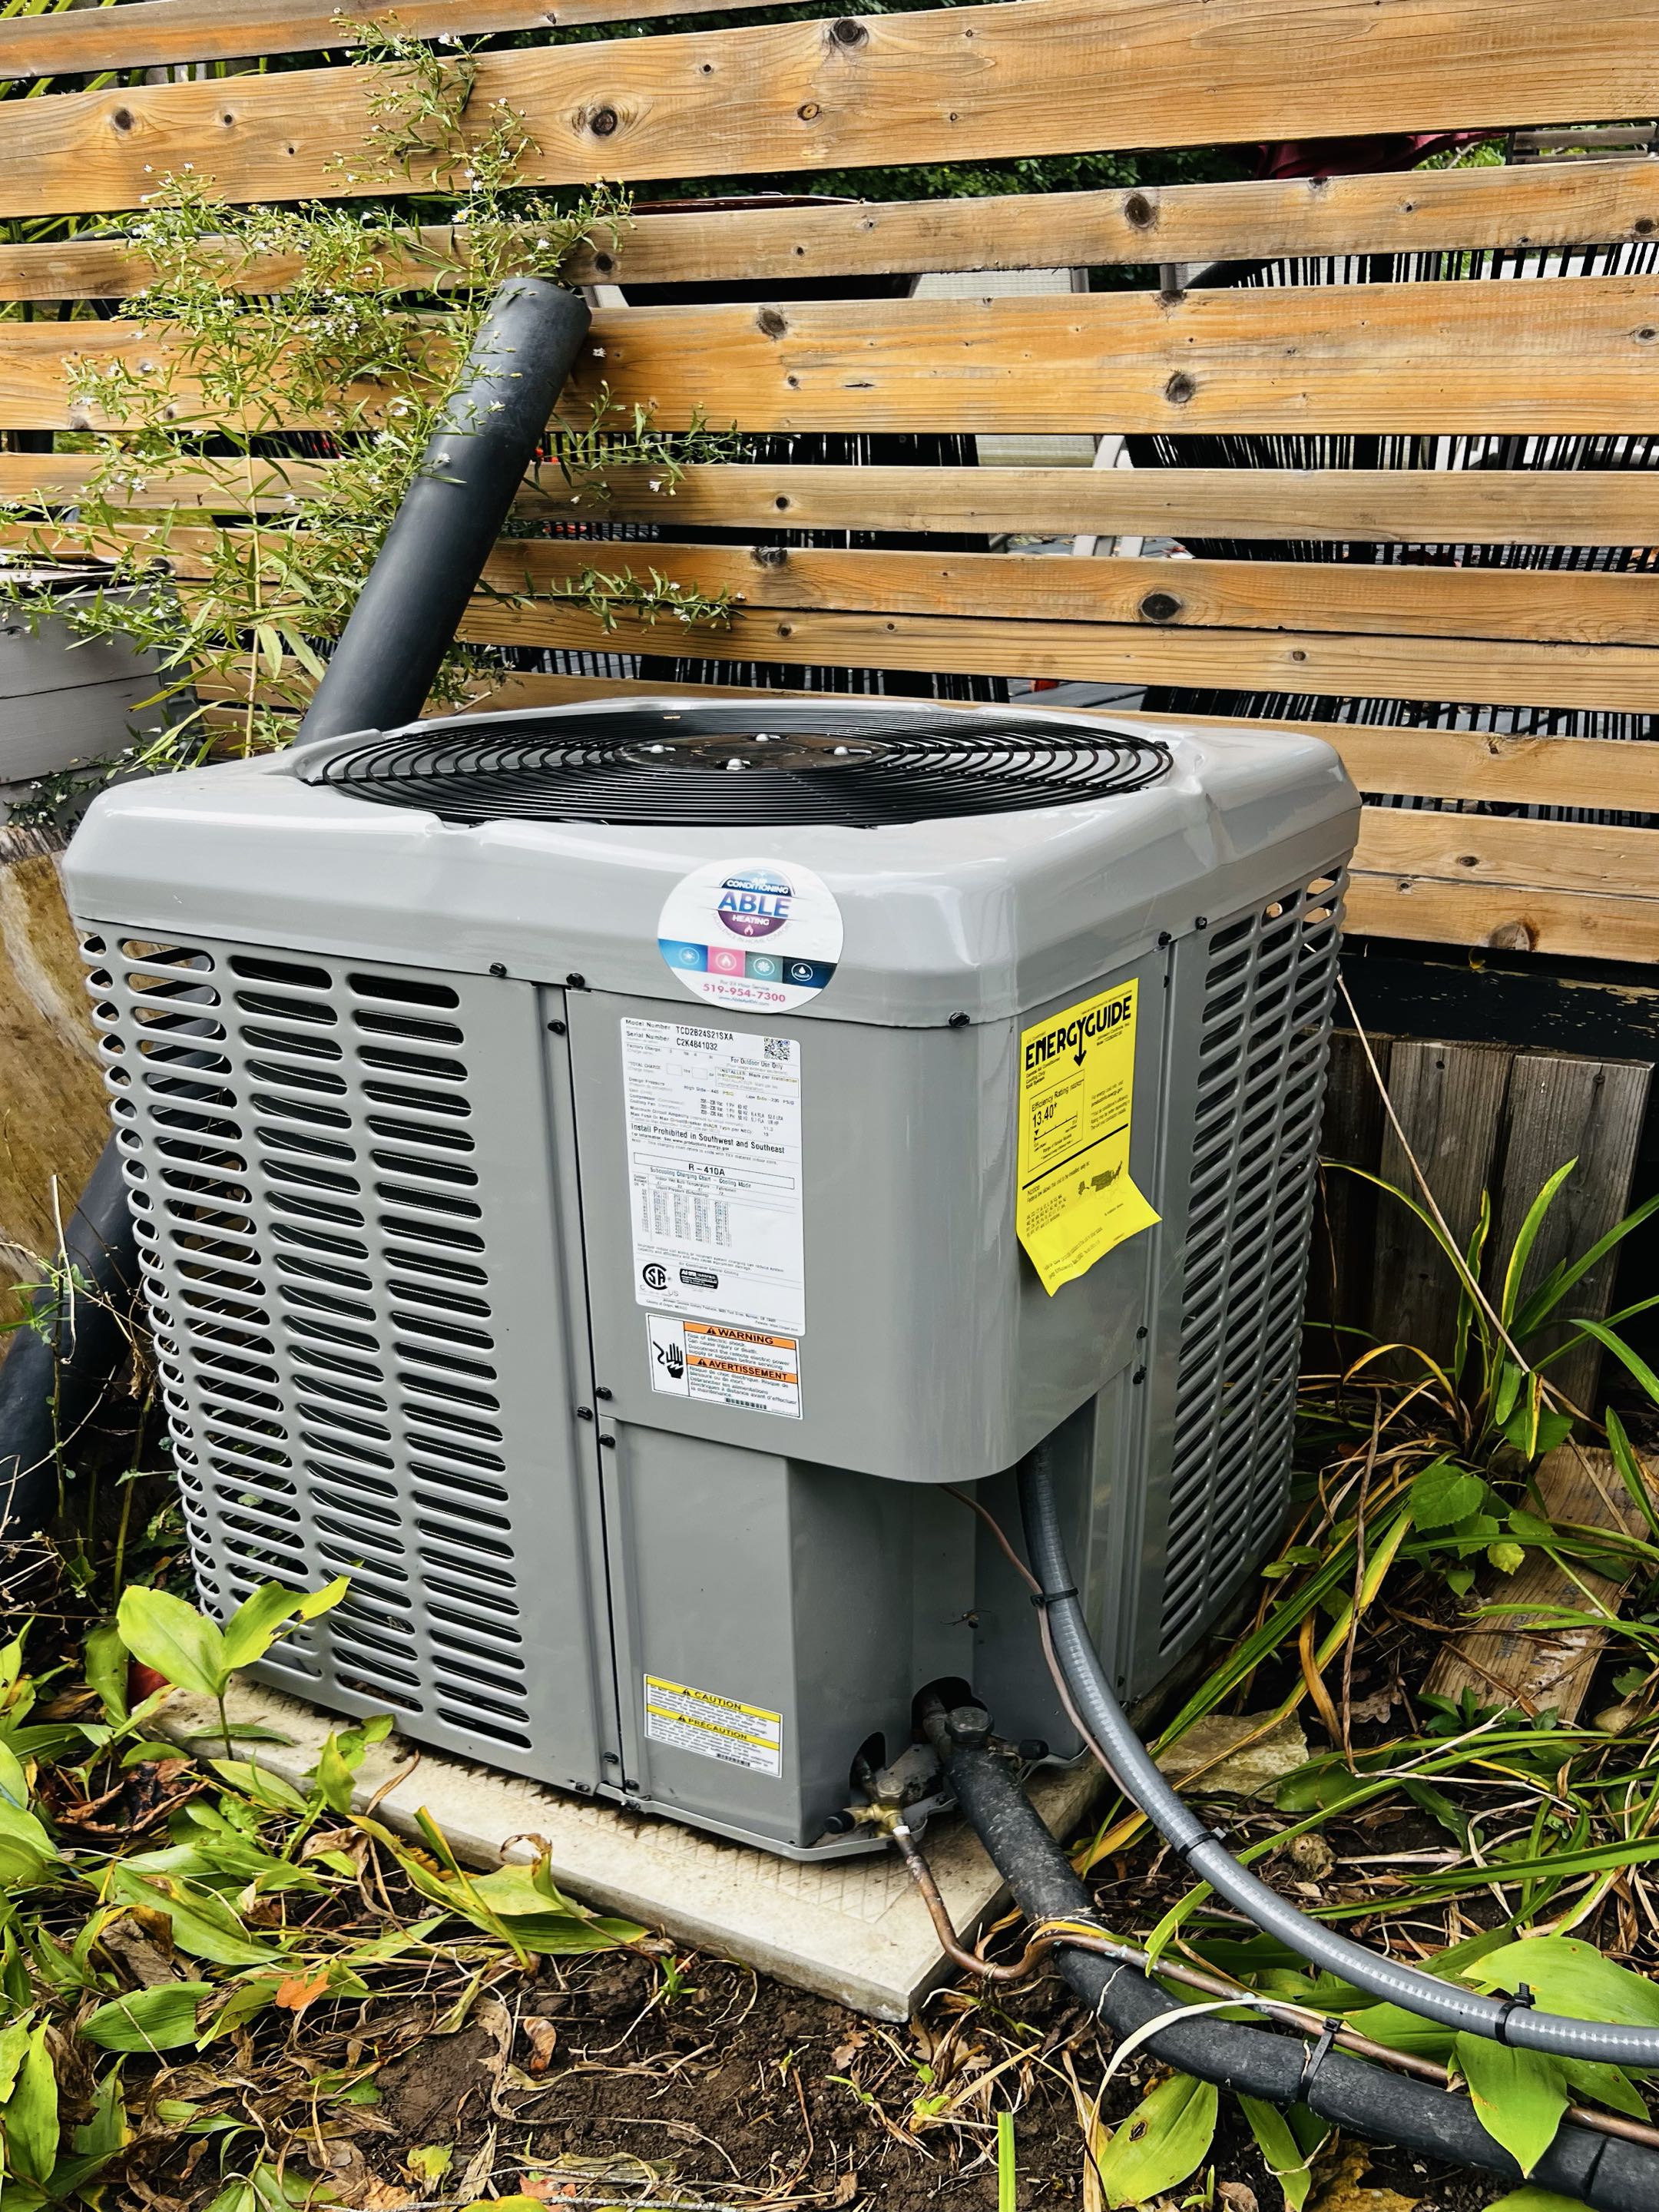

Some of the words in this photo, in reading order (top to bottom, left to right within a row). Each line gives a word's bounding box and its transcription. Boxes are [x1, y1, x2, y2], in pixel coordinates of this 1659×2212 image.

[727, 880, 789, 894] CONDITIONING
[718, 891, 791, 918] ABLE
[733, 915, 769, 926] HEATING
[704, 983, 786, 1002] 519-954-7300
[646, 1033, 669, 1041] Number
[740, 1058, 759, 1067] Outdoor
[1032, 1096, 1053, 1111] Efficiency
[1055, 1087, 1069, 1098] Rating
[631, 1123, 651, 1133] Install
[654, 1126, 687, 1138] Prohibited
[699, 1133, 733, 1146] Southwest
[751, 1141, 784, 1154] Southeast
[677, 1171, 697, 1181] Charging
[719, 1177, 737, 1187] Cooling
[718, 1328, 773, 1345] WARNING
[709, 1360, 787, 1380] AVERTISSEMENT
[694, 1691, 741, 1710] CAUTION
[688, 1717, 747, 1740] PRÉCAUTION
